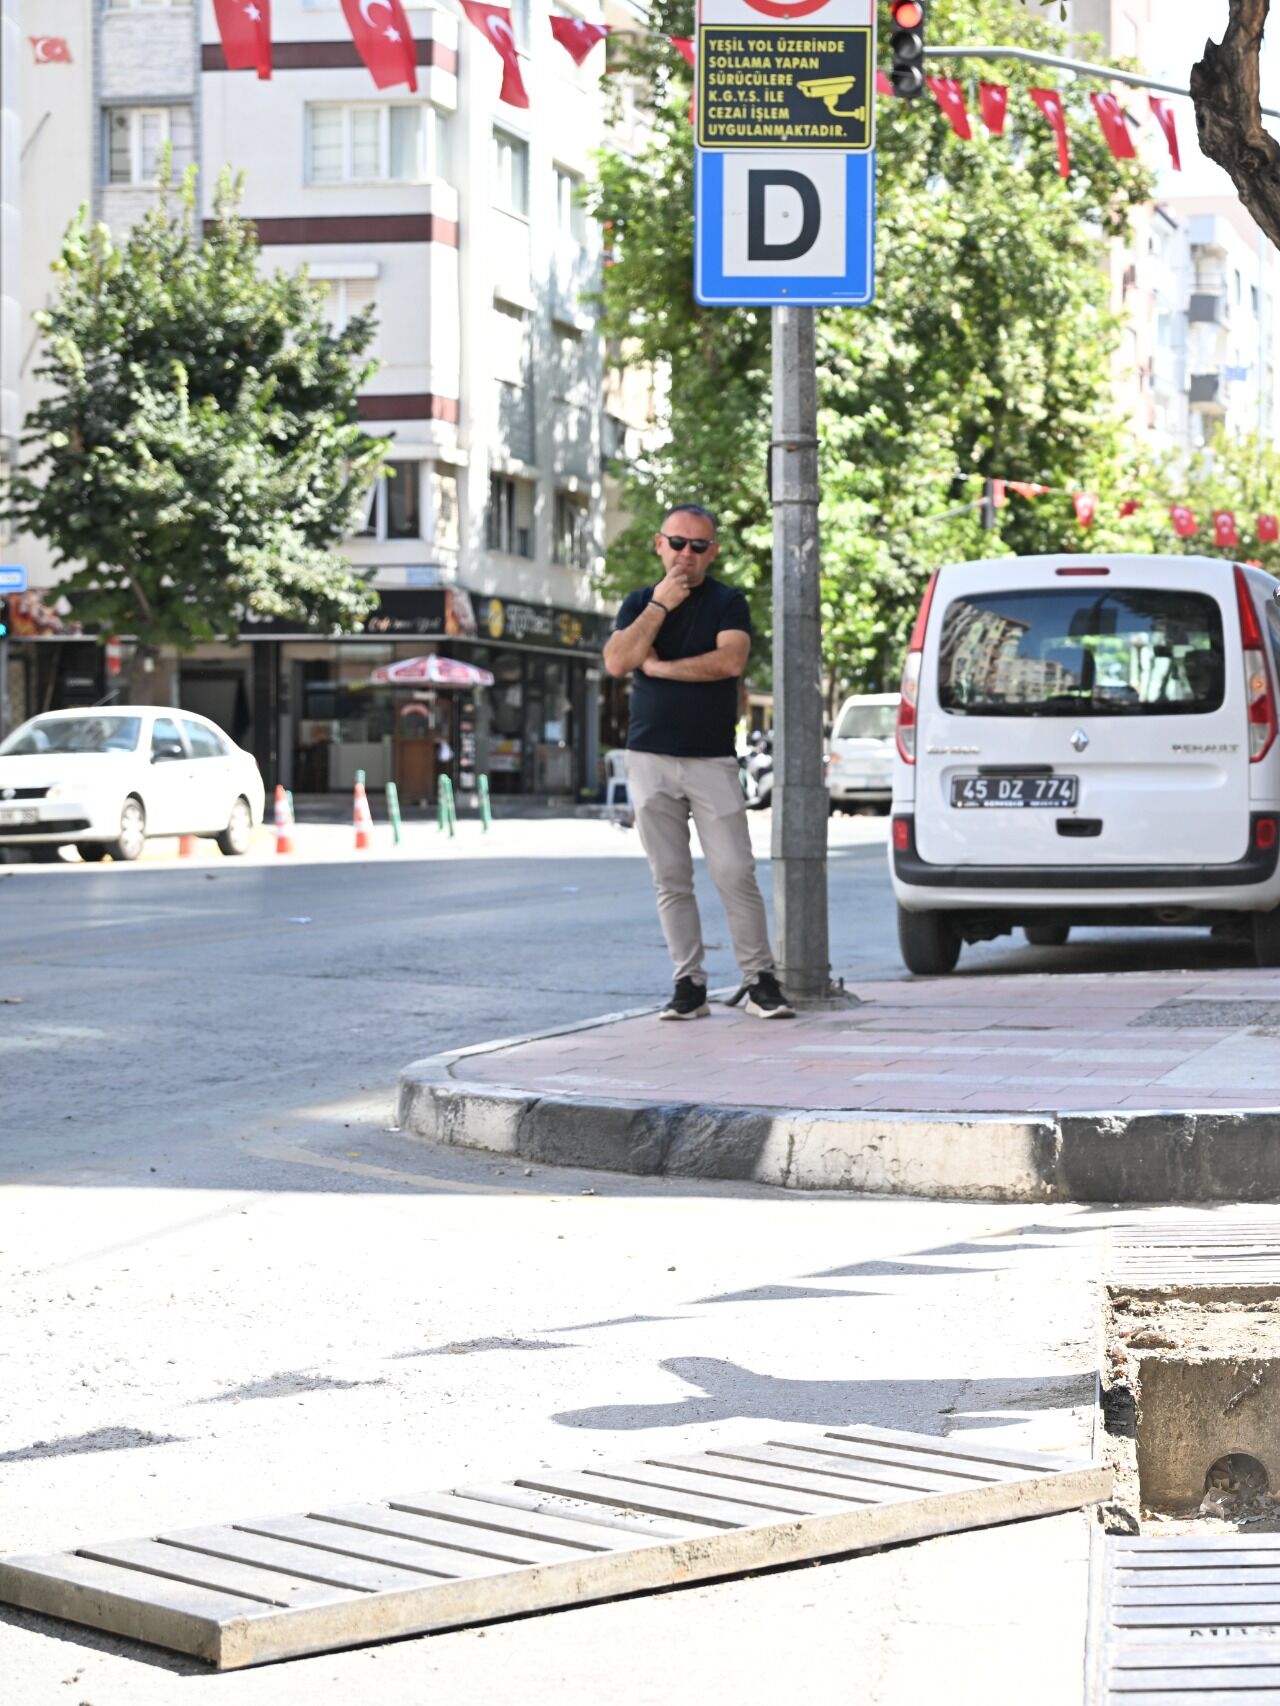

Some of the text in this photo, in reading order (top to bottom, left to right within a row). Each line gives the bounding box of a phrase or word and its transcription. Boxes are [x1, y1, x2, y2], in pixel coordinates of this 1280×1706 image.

[708, 37, 845, 54] YEŞİL YOL ÜZERİNDE
[708, 56, 820, 69] SOLLAMA YAPAN
[708, 71, 793, 86] SÜRÜCÜLERE
[708, 88, 785, 103] K.G.Y.S. İLE
[708, 104, 790, 122] CEZAİ İŞLEM
[708, 124, 848, 137] UYGULANMAKTADIR.
[747, 169, 821, 261] D
[962, 780, 1072, 799] 45 DZ 774
